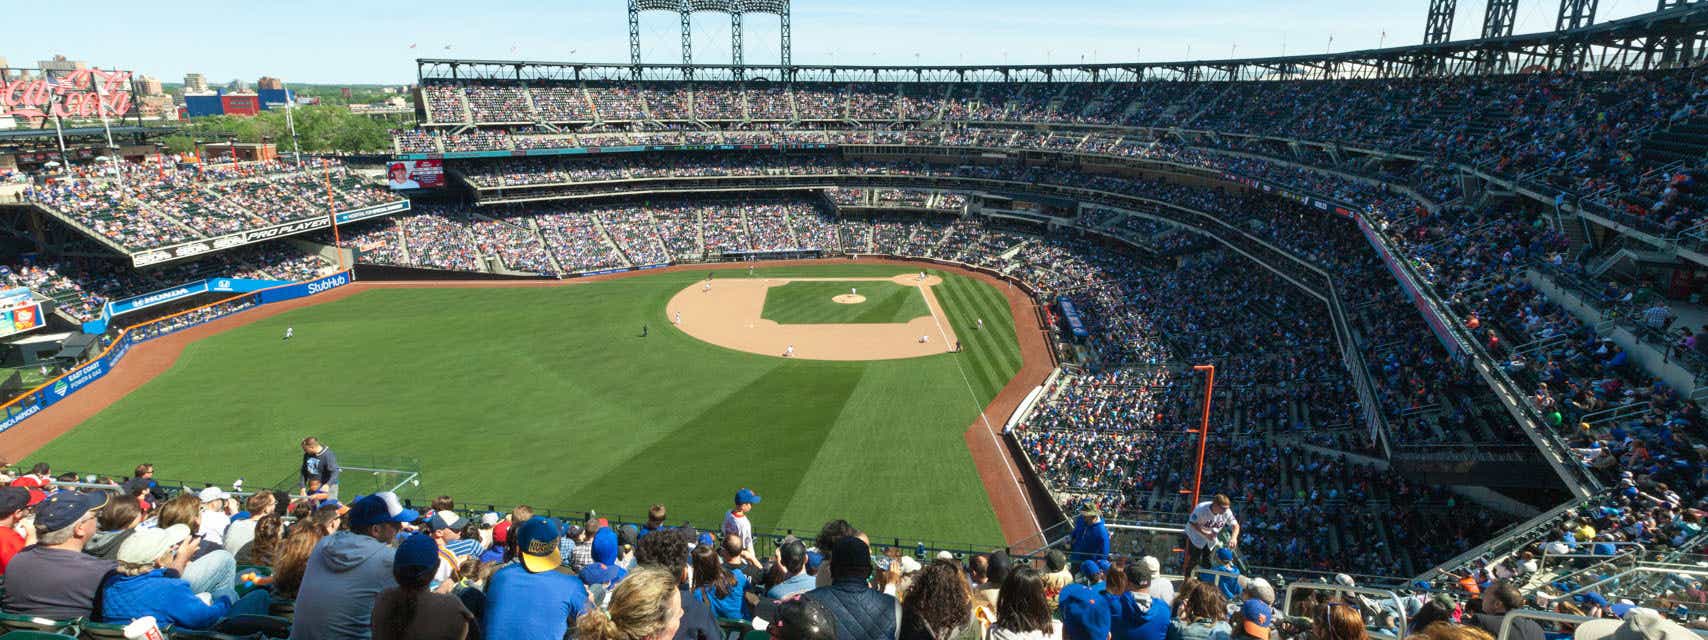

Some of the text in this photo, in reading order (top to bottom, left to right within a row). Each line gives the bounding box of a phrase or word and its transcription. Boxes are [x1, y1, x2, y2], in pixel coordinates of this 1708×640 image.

[247, 227, 278, 241] PRO
[278, 218, 329, 236] PLAYER
[144, 288, 189, 303] HONDA
[307, 275, 345, 295] StubHub
[68, 361, 100, 382] EAST COAST
[0, 404, 40, 433] NICA MINOLTA
